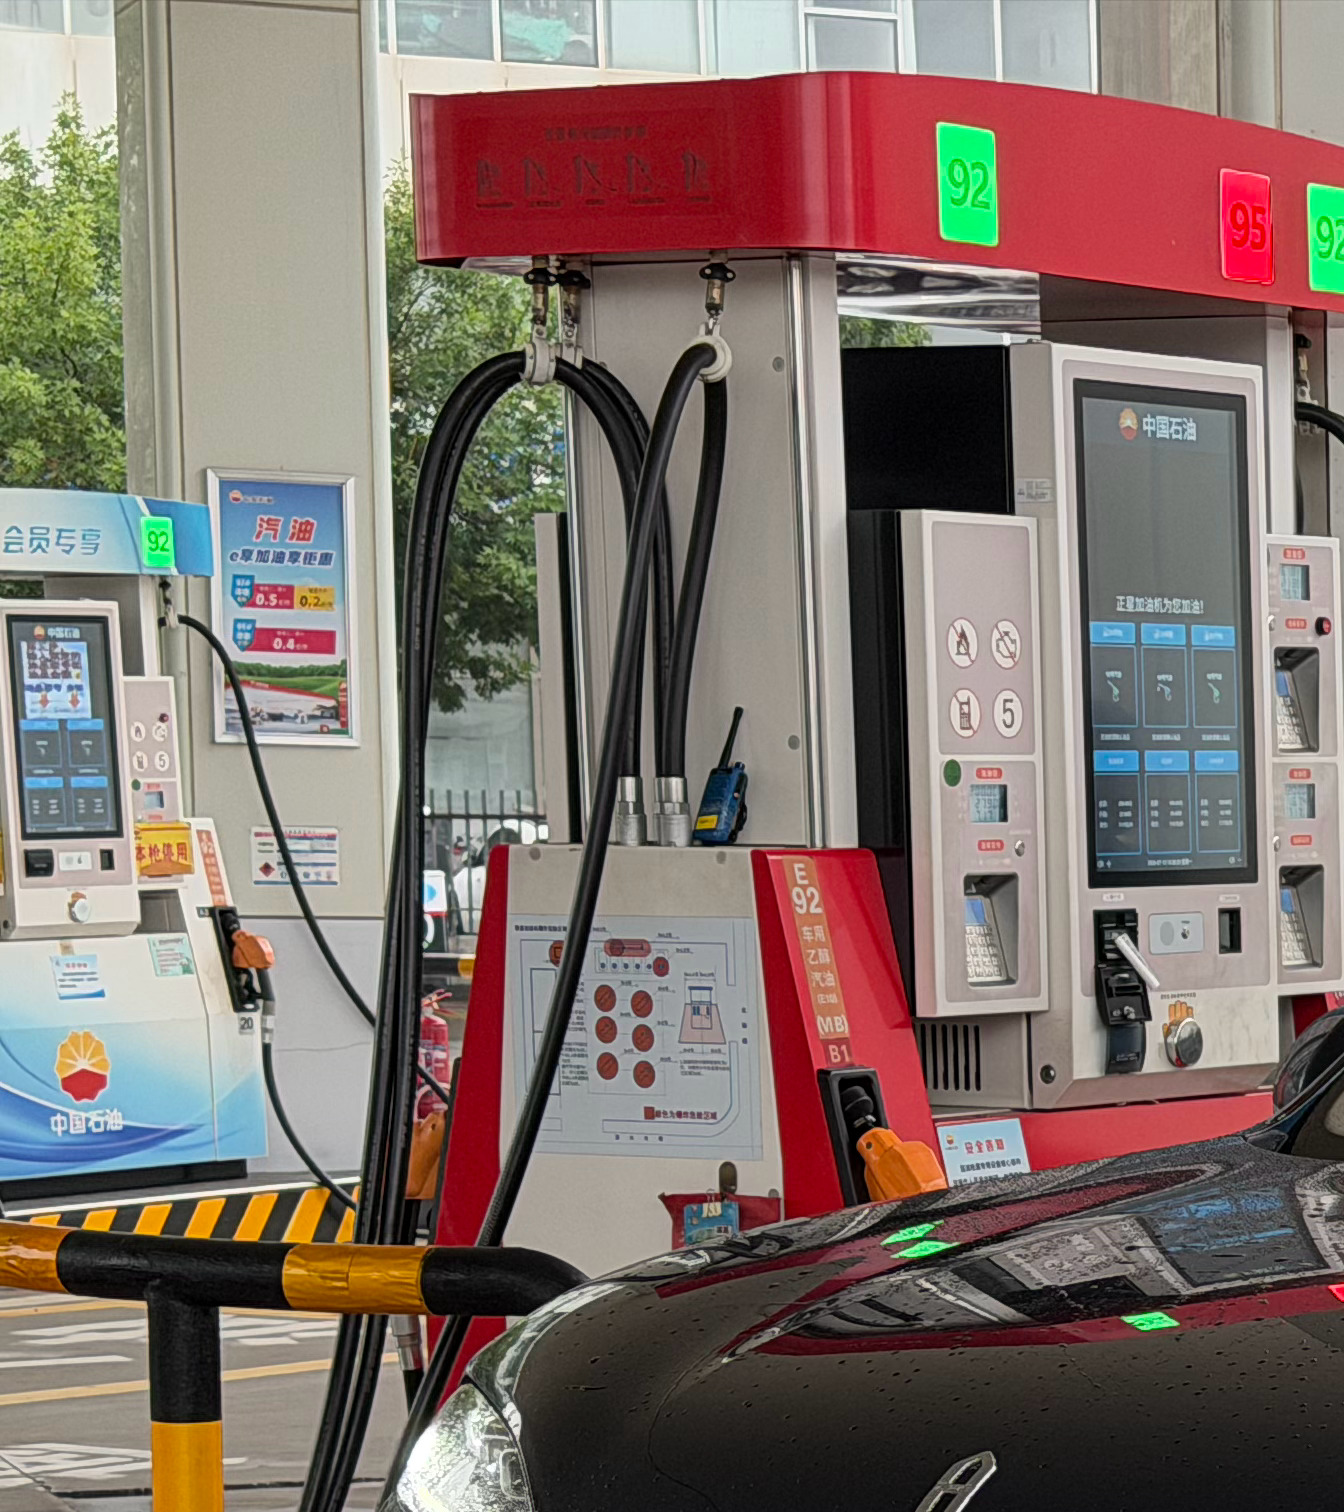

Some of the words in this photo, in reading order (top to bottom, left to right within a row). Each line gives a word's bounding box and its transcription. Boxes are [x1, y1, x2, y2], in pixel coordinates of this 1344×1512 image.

[947, 157, 991, 210] 92
[1229, 202, 1266, 250] 95
[1142, 413, 1197, 441] 中国石油
[3, 525, 102, 556] 会员专享
[147, 530, 170, 553] 92
[253, 516, 317, 542] 汽油
[1002, 698, 1015, 729] 5
[793, 863, 809, 885] E
[791, 886, 823, 914] 92
[802, 924, 826, 942] 车用
[806, 948, 831, 965] 乙醇
[811, 971, 836, 988] 汽油
[240, 1016, 254, 1030] 20
[828, 1044, 851, 1064] B1
[50, 1108, 124, 1137] 中国石油
